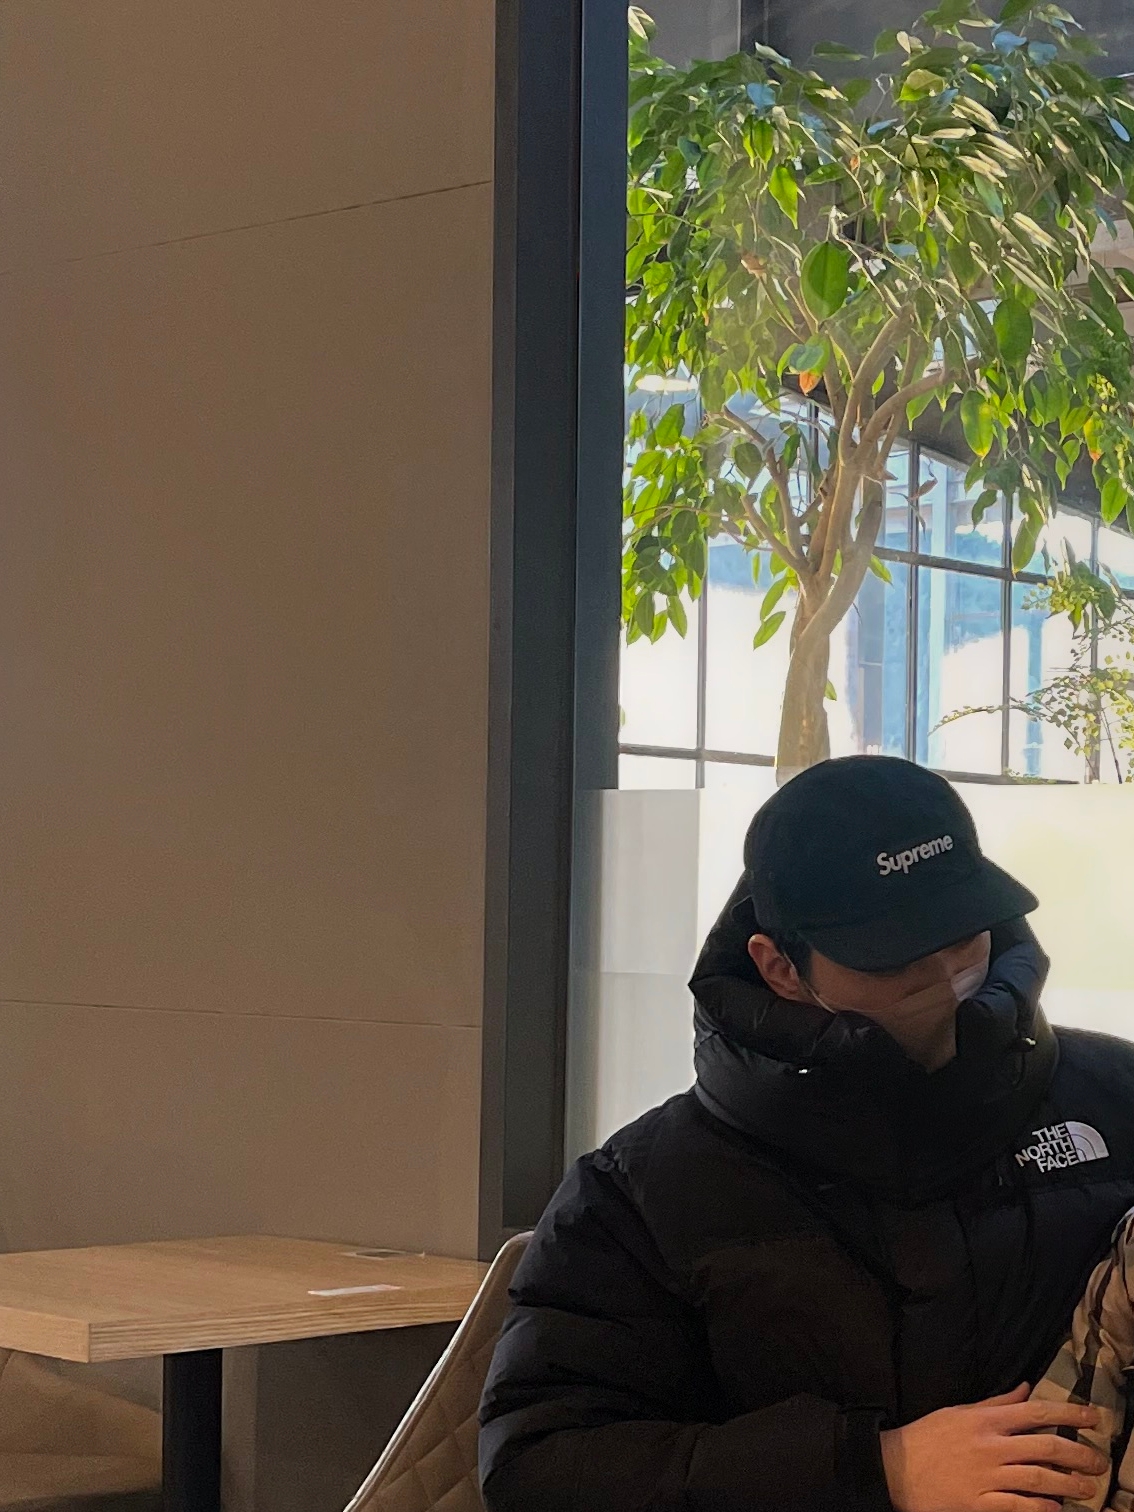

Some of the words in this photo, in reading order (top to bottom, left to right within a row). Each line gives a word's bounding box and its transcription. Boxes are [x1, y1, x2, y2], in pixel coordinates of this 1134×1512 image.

[877, 835, 954, 876] Supreme
[1032, 1123, 1069, 1143] THE
[1014, 1136, 1076, 1167] NORTH
[1037, 1151, 1079, 1173] FACE
